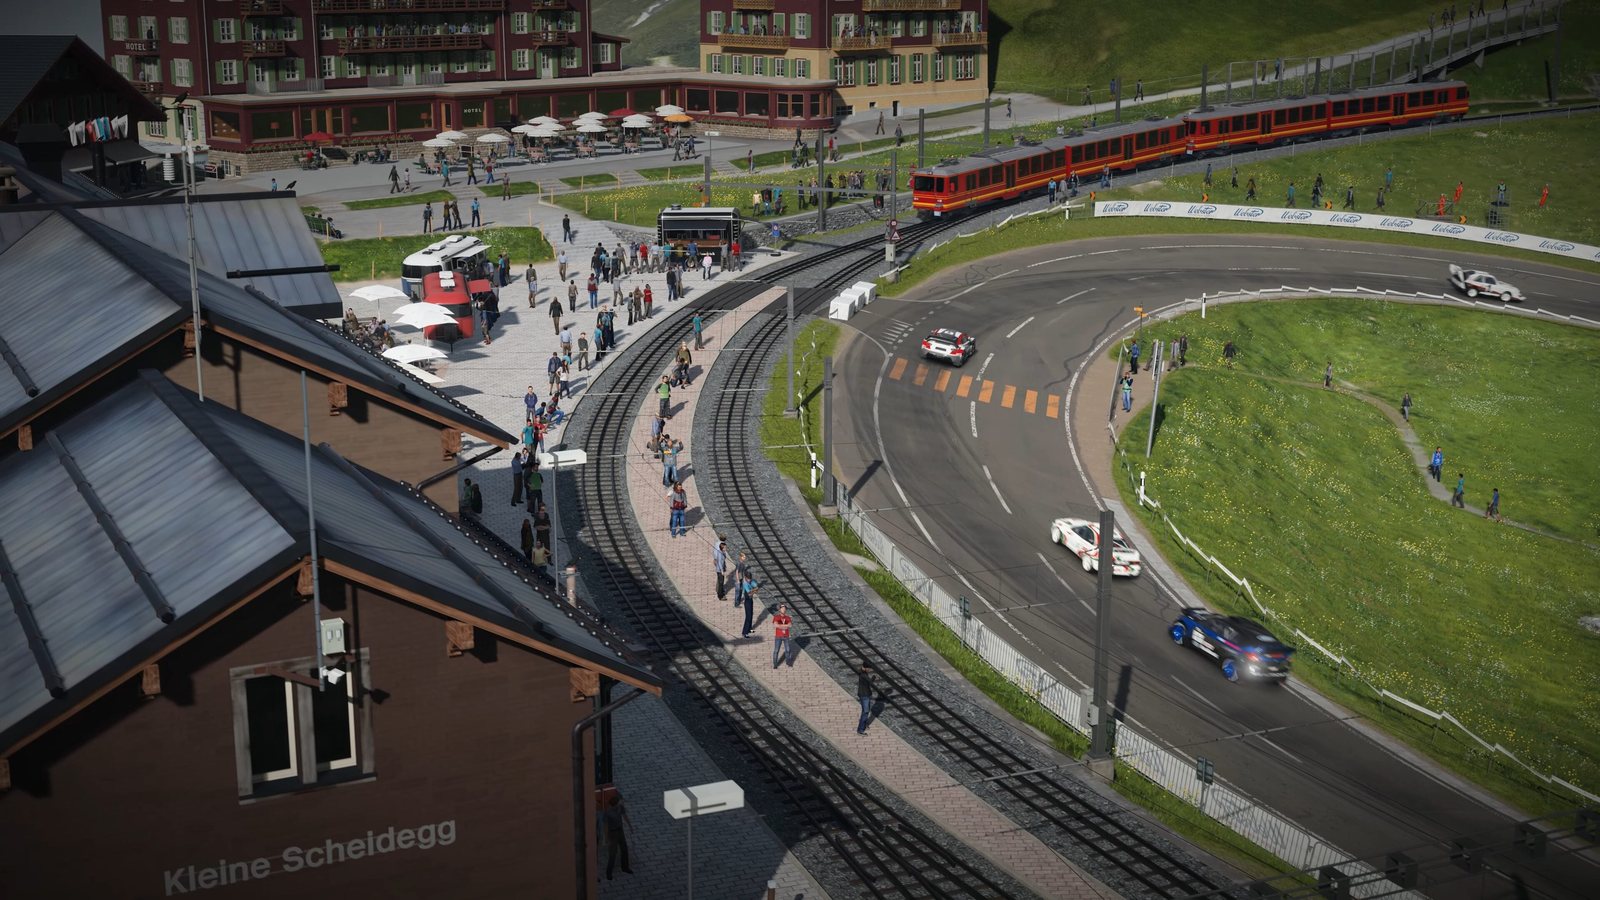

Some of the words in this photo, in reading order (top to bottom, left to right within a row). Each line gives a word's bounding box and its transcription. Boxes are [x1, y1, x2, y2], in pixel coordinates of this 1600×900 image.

[125, 42, 146, 50] HOTEL
[164, 857, 271, 896] Kleine
[282, 820, 456, 872] Scheidegg
